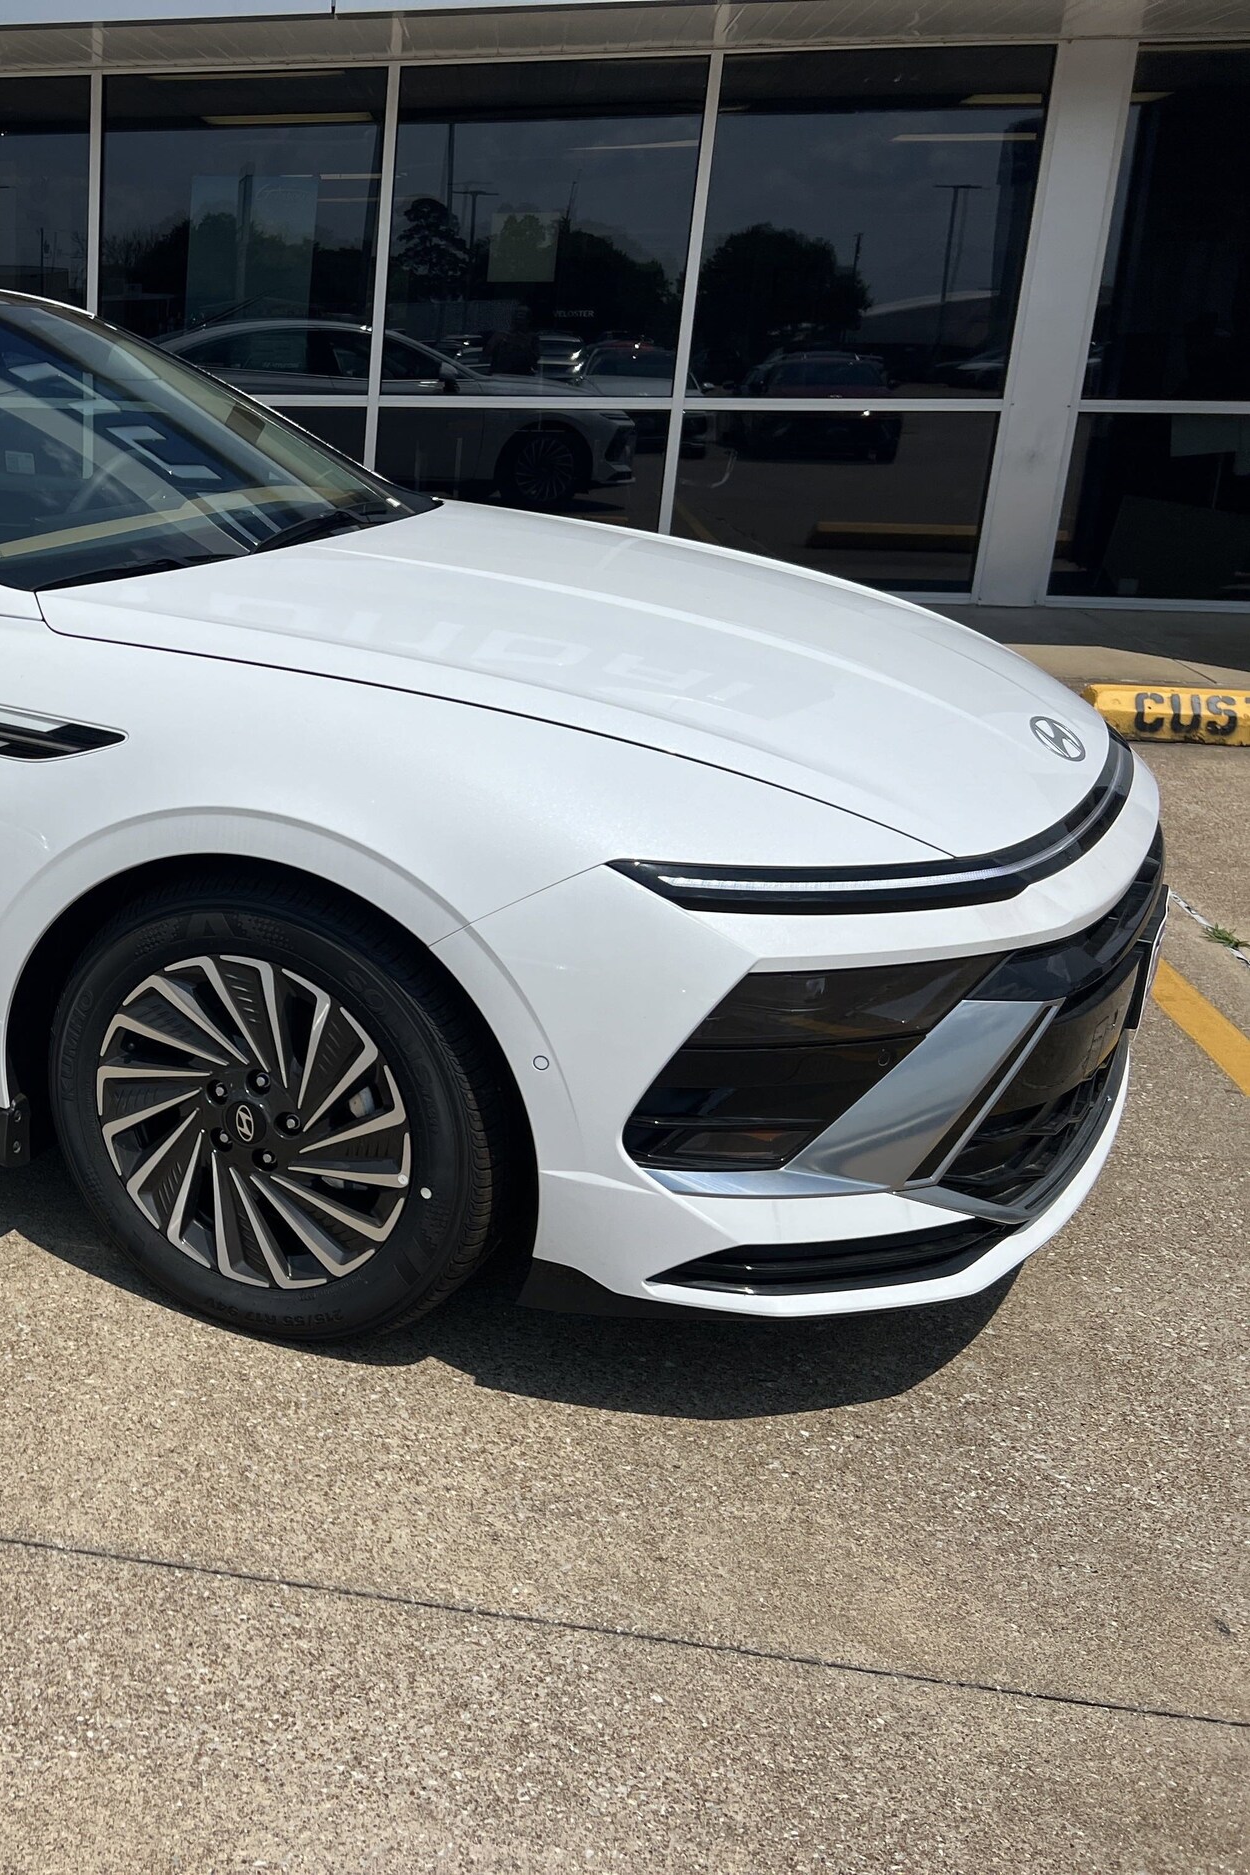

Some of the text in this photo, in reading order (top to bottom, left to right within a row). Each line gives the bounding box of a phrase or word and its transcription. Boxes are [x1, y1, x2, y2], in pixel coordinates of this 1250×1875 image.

[551, 309, 596, 319] VELOSTER
[1134, 692, 1250, 736] CUS
[59, 988, 96, 1103] KUMHO
